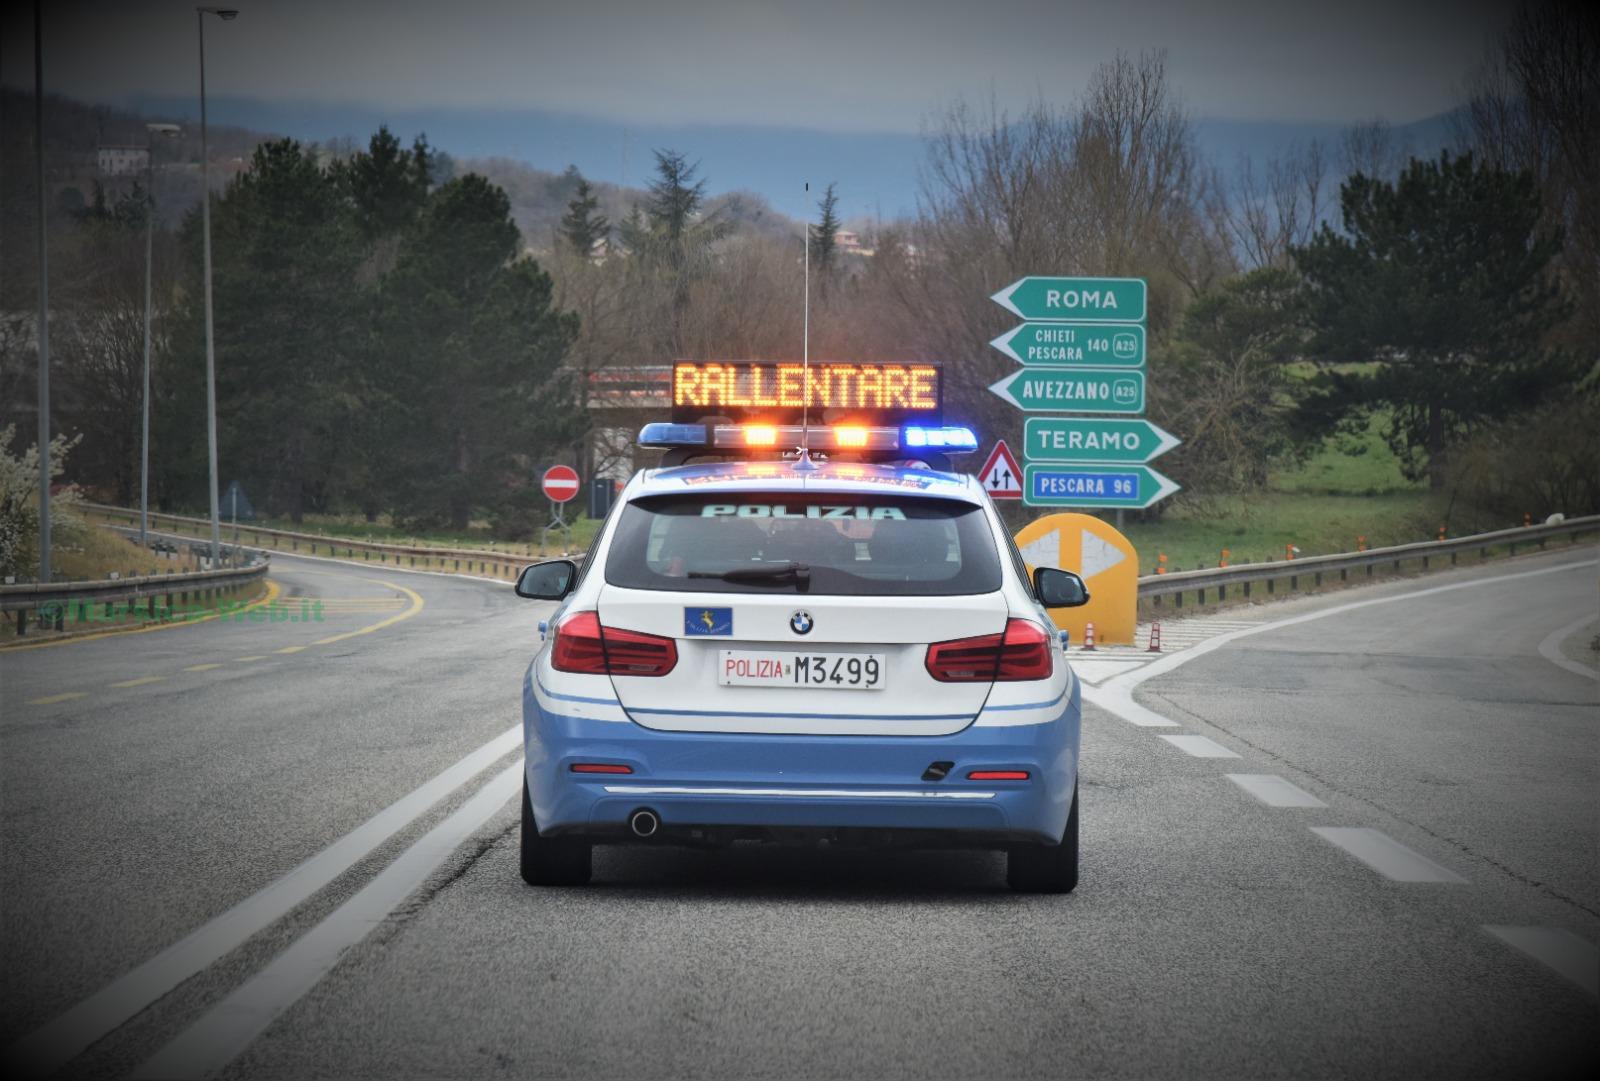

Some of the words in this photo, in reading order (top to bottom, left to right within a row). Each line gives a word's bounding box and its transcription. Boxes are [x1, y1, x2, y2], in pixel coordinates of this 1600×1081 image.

[1046, 290, 1118, 309] ROMA
[1035, 330, 1075, 343] CHIETI
[1087, 339, 1109, 352] 140
[1115, 341, 1136, 352] A25
[1028, 346, 1083, 360] PESCARA
[674, 365, 937, 409] RALLENTARE
[1023, 380, 1110, 400] AVEZZANO
[1115, 386, 1136, 397] A25
[1037, 430, 1141, 450] TERAMO
[1041, 477, 1105, 494] PESCARA
[1113, 479, 1132, 494] 96
[701, 504, 907, 521] POLIZIA
[725, 659, 783, 678] POLIZIA
[794, 656, 880, 686] M3499
